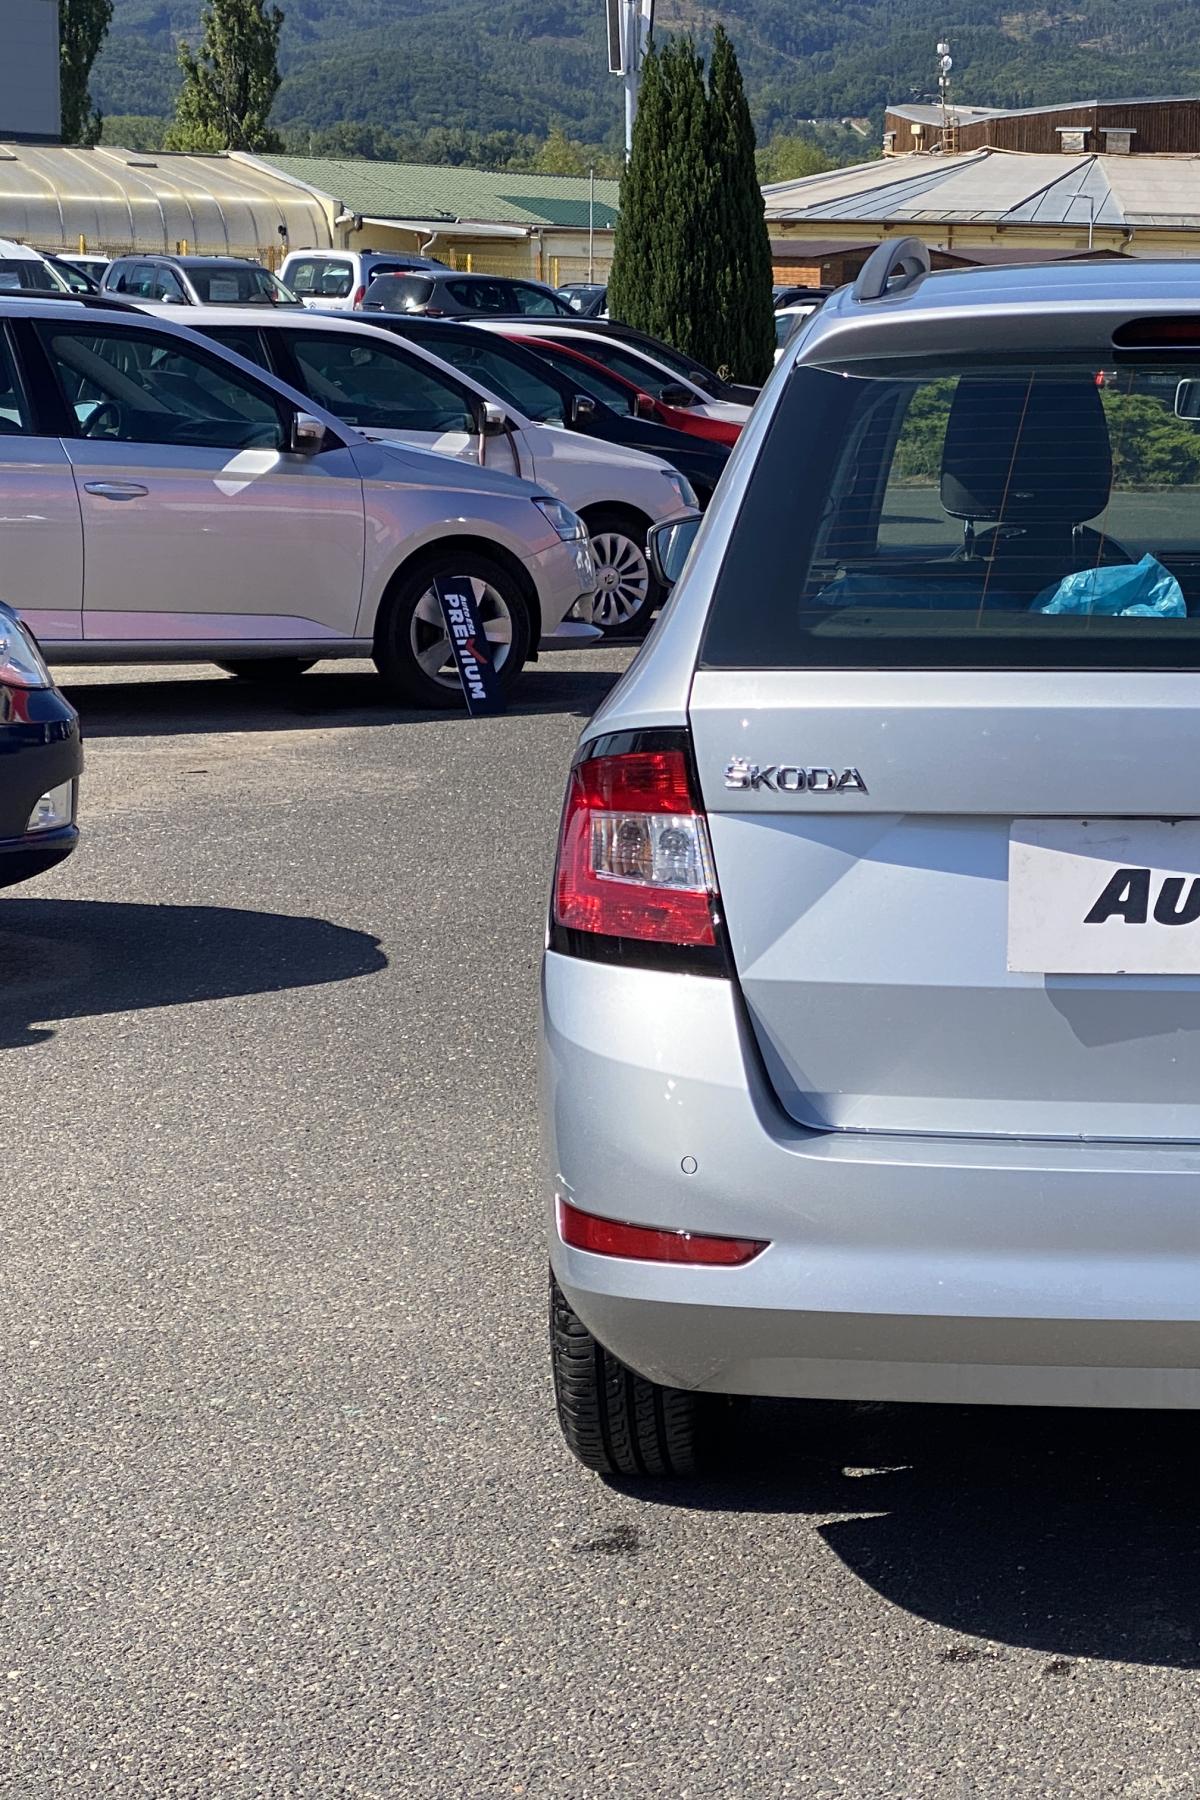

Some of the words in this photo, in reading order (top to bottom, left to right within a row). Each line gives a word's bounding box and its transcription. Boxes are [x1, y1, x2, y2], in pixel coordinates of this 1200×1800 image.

[459, 594, 471, 617] Auto
[465, 617, 476, 636] ESA
[723, 756, 869, 796] ŠKODA
